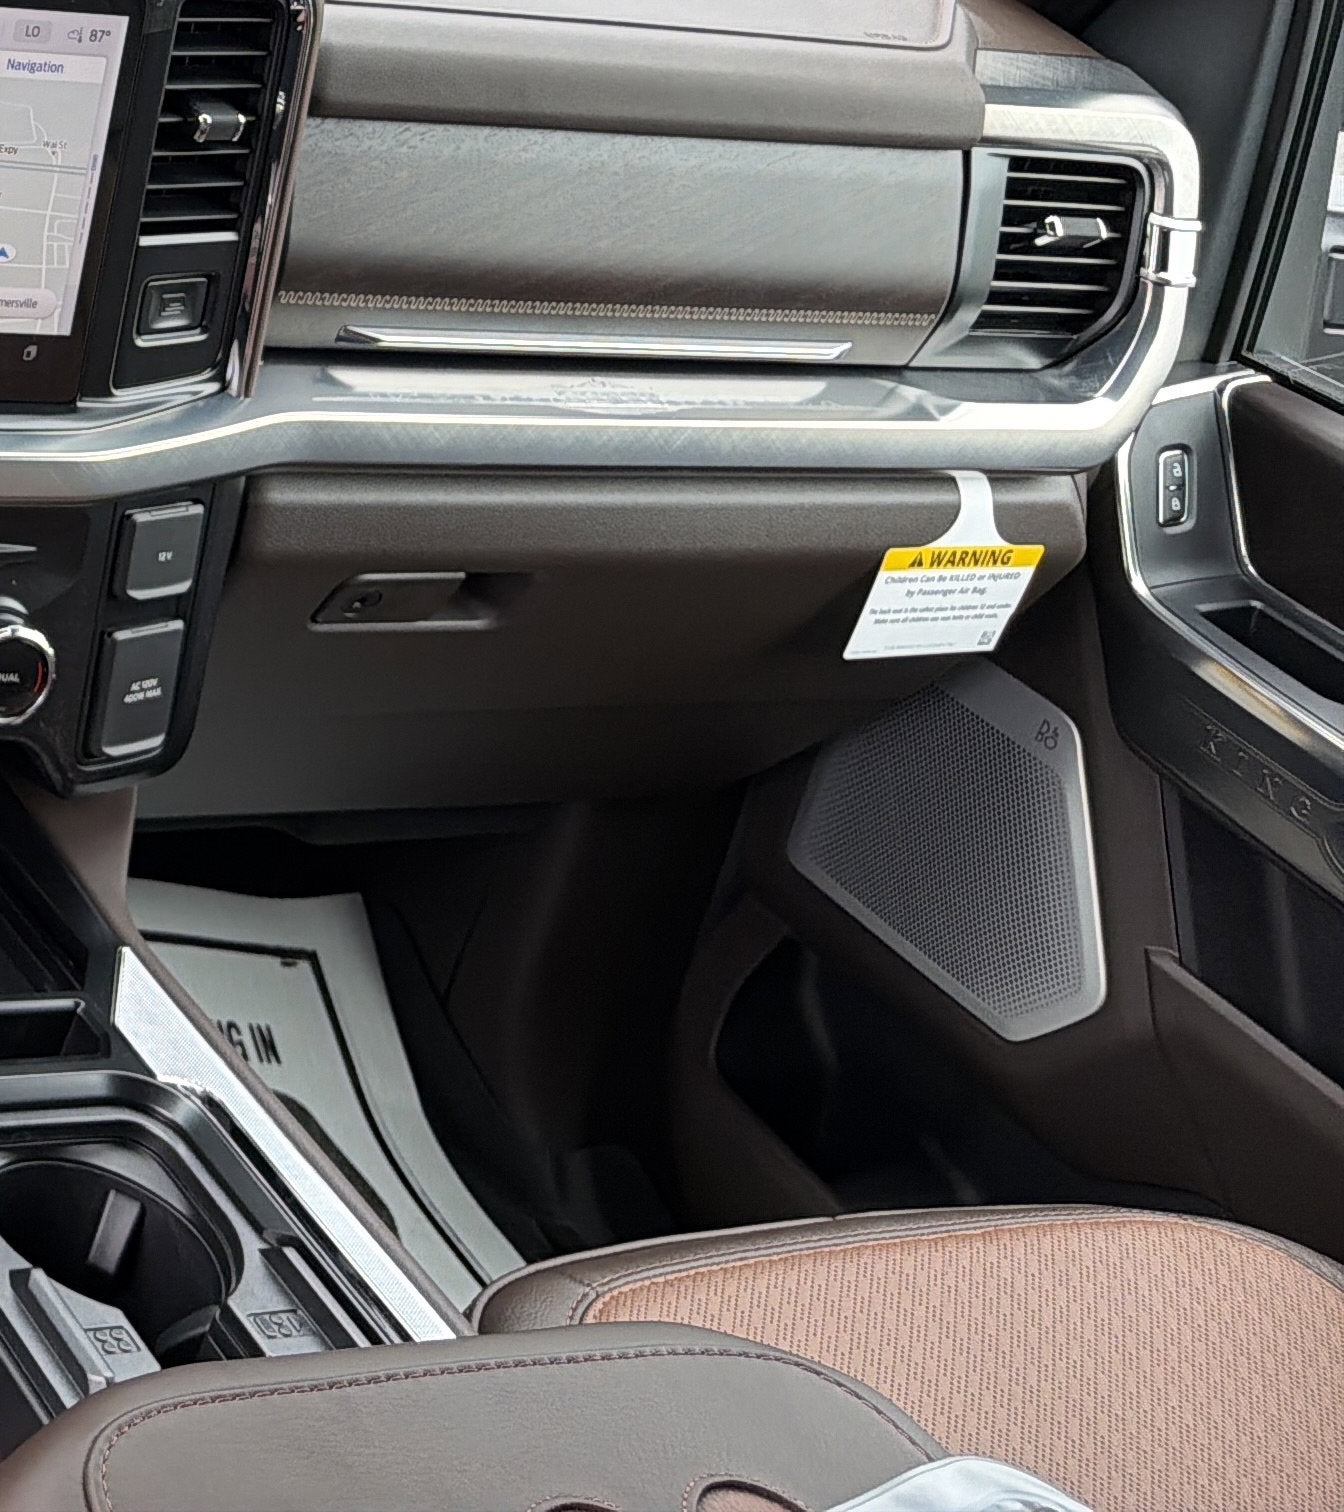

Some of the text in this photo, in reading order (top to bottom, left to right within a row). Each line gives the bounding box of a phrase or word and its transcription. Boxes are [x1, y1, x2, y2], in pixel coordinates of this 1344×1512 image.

[25, 25, 40, 38] LO
[6, 58, 64, 75] Navigation
[158, 551, 173, 562] 12V
[930, 549, 1013, 567] WARNING
[885, 575, 918, 584] Children
[949, 574, 974, 582] KILLED
[987, 572, 1021, 581] INJURED
[905, 590, 915, 598] by
[917, 588, 956, 597] Passenger
[130, 681, 140, 691] AC
[248, 1023, 281, 1065] IN
